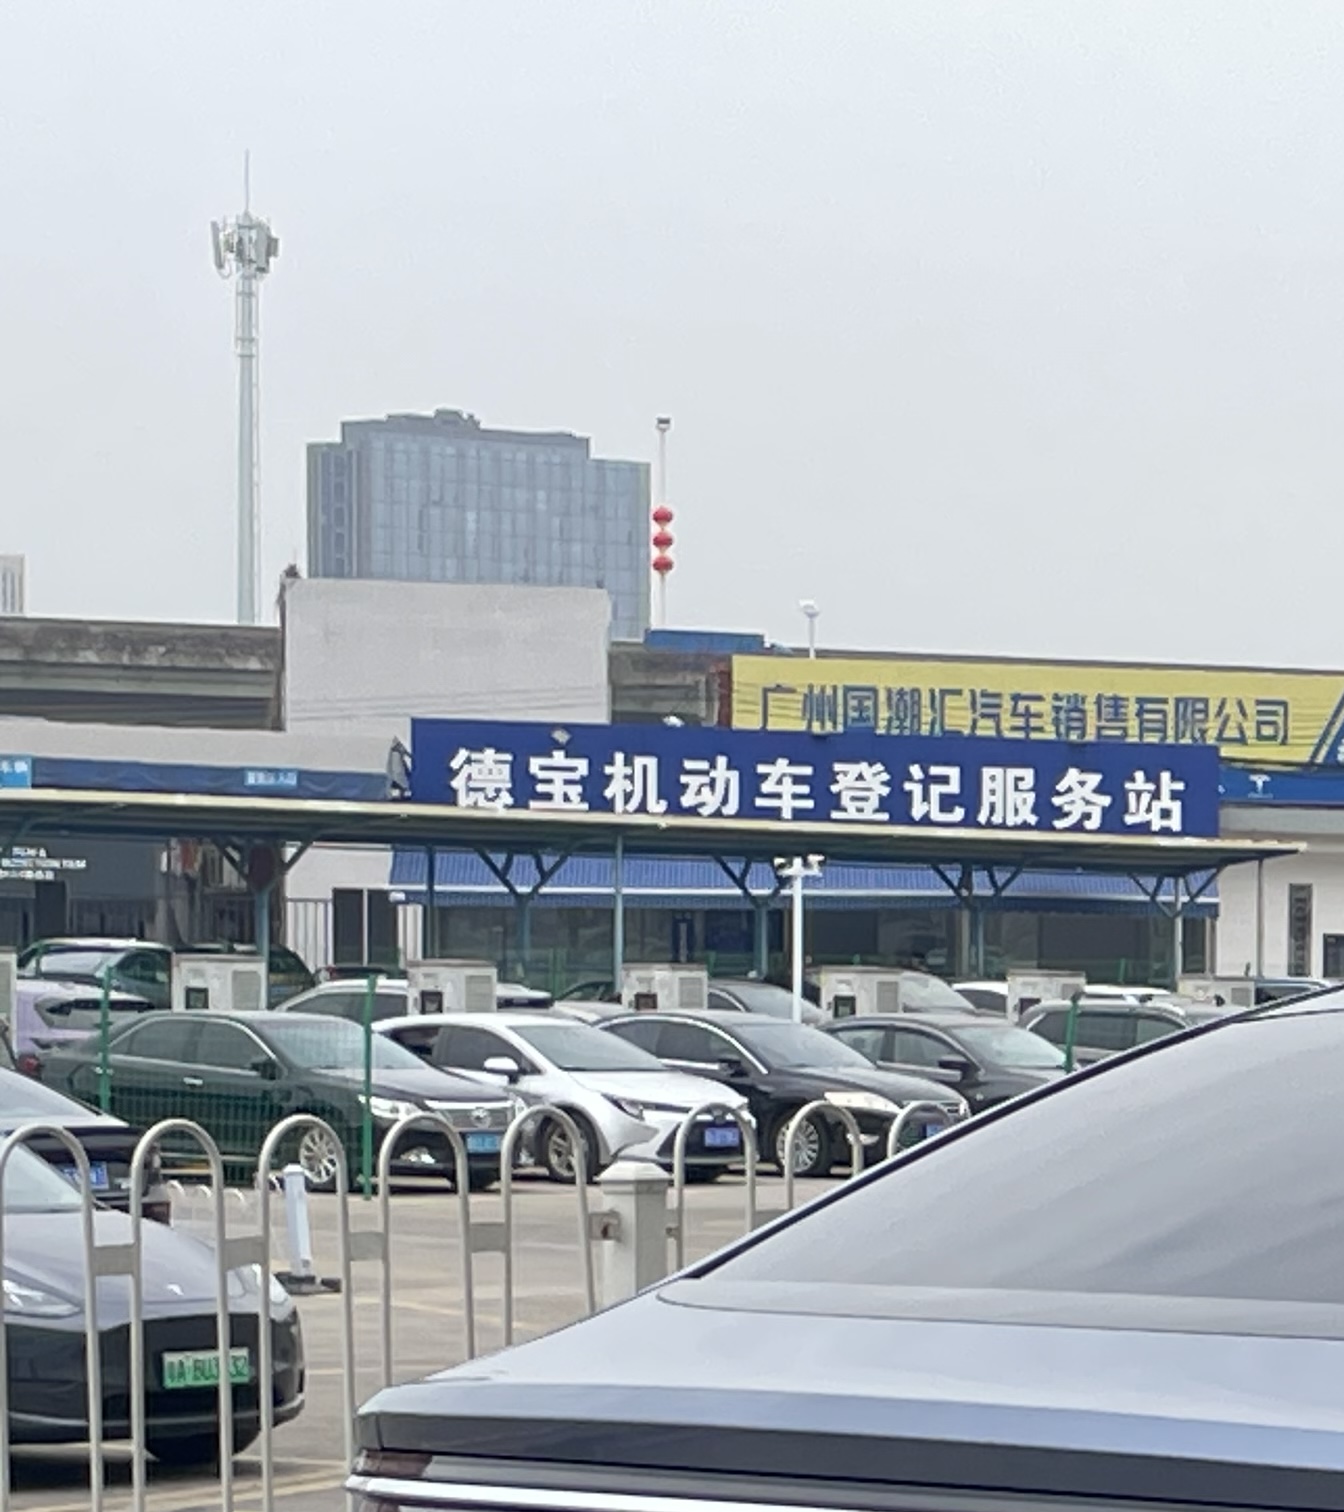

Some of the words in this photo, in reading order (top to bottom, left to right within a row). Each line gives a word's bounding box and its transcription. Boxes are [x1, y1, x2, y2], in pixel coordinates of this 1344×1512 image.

[759, 682, 1290, 746] 广州国潮汇汽车销售有限公司
[449, 747, 1187, 832] 德宝机动车登记服务站
